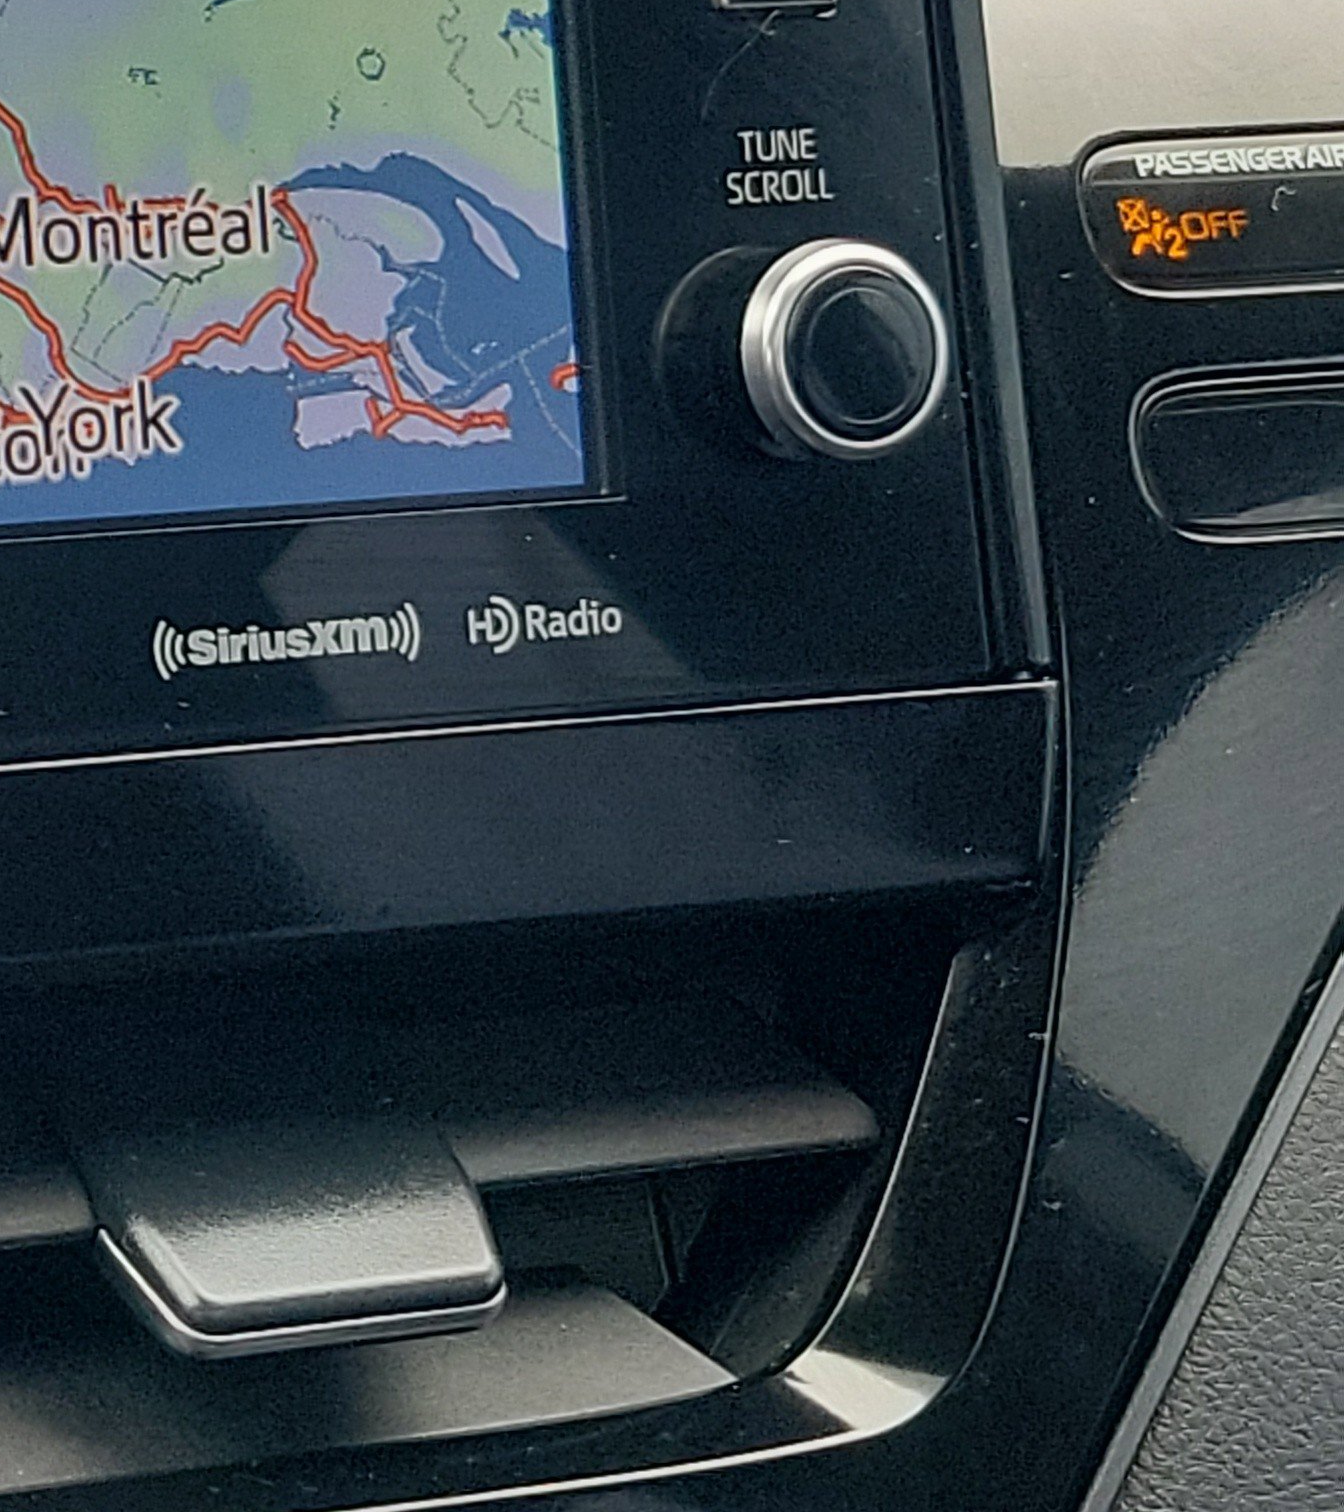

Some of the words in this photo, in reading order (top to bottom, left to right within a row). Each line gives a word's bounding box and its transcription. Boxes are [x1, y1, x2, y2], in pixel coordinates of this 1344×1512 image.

[736, 127, 819, 163] TUNE
[1132, 145, 1305, 178] PASSENGER
[725, 167, 837, 206] SCROLL
[1179, 208, 1249, 241] OFF
[17, 377, 179, 457] York
[524, 597, 622, 640] Radio
